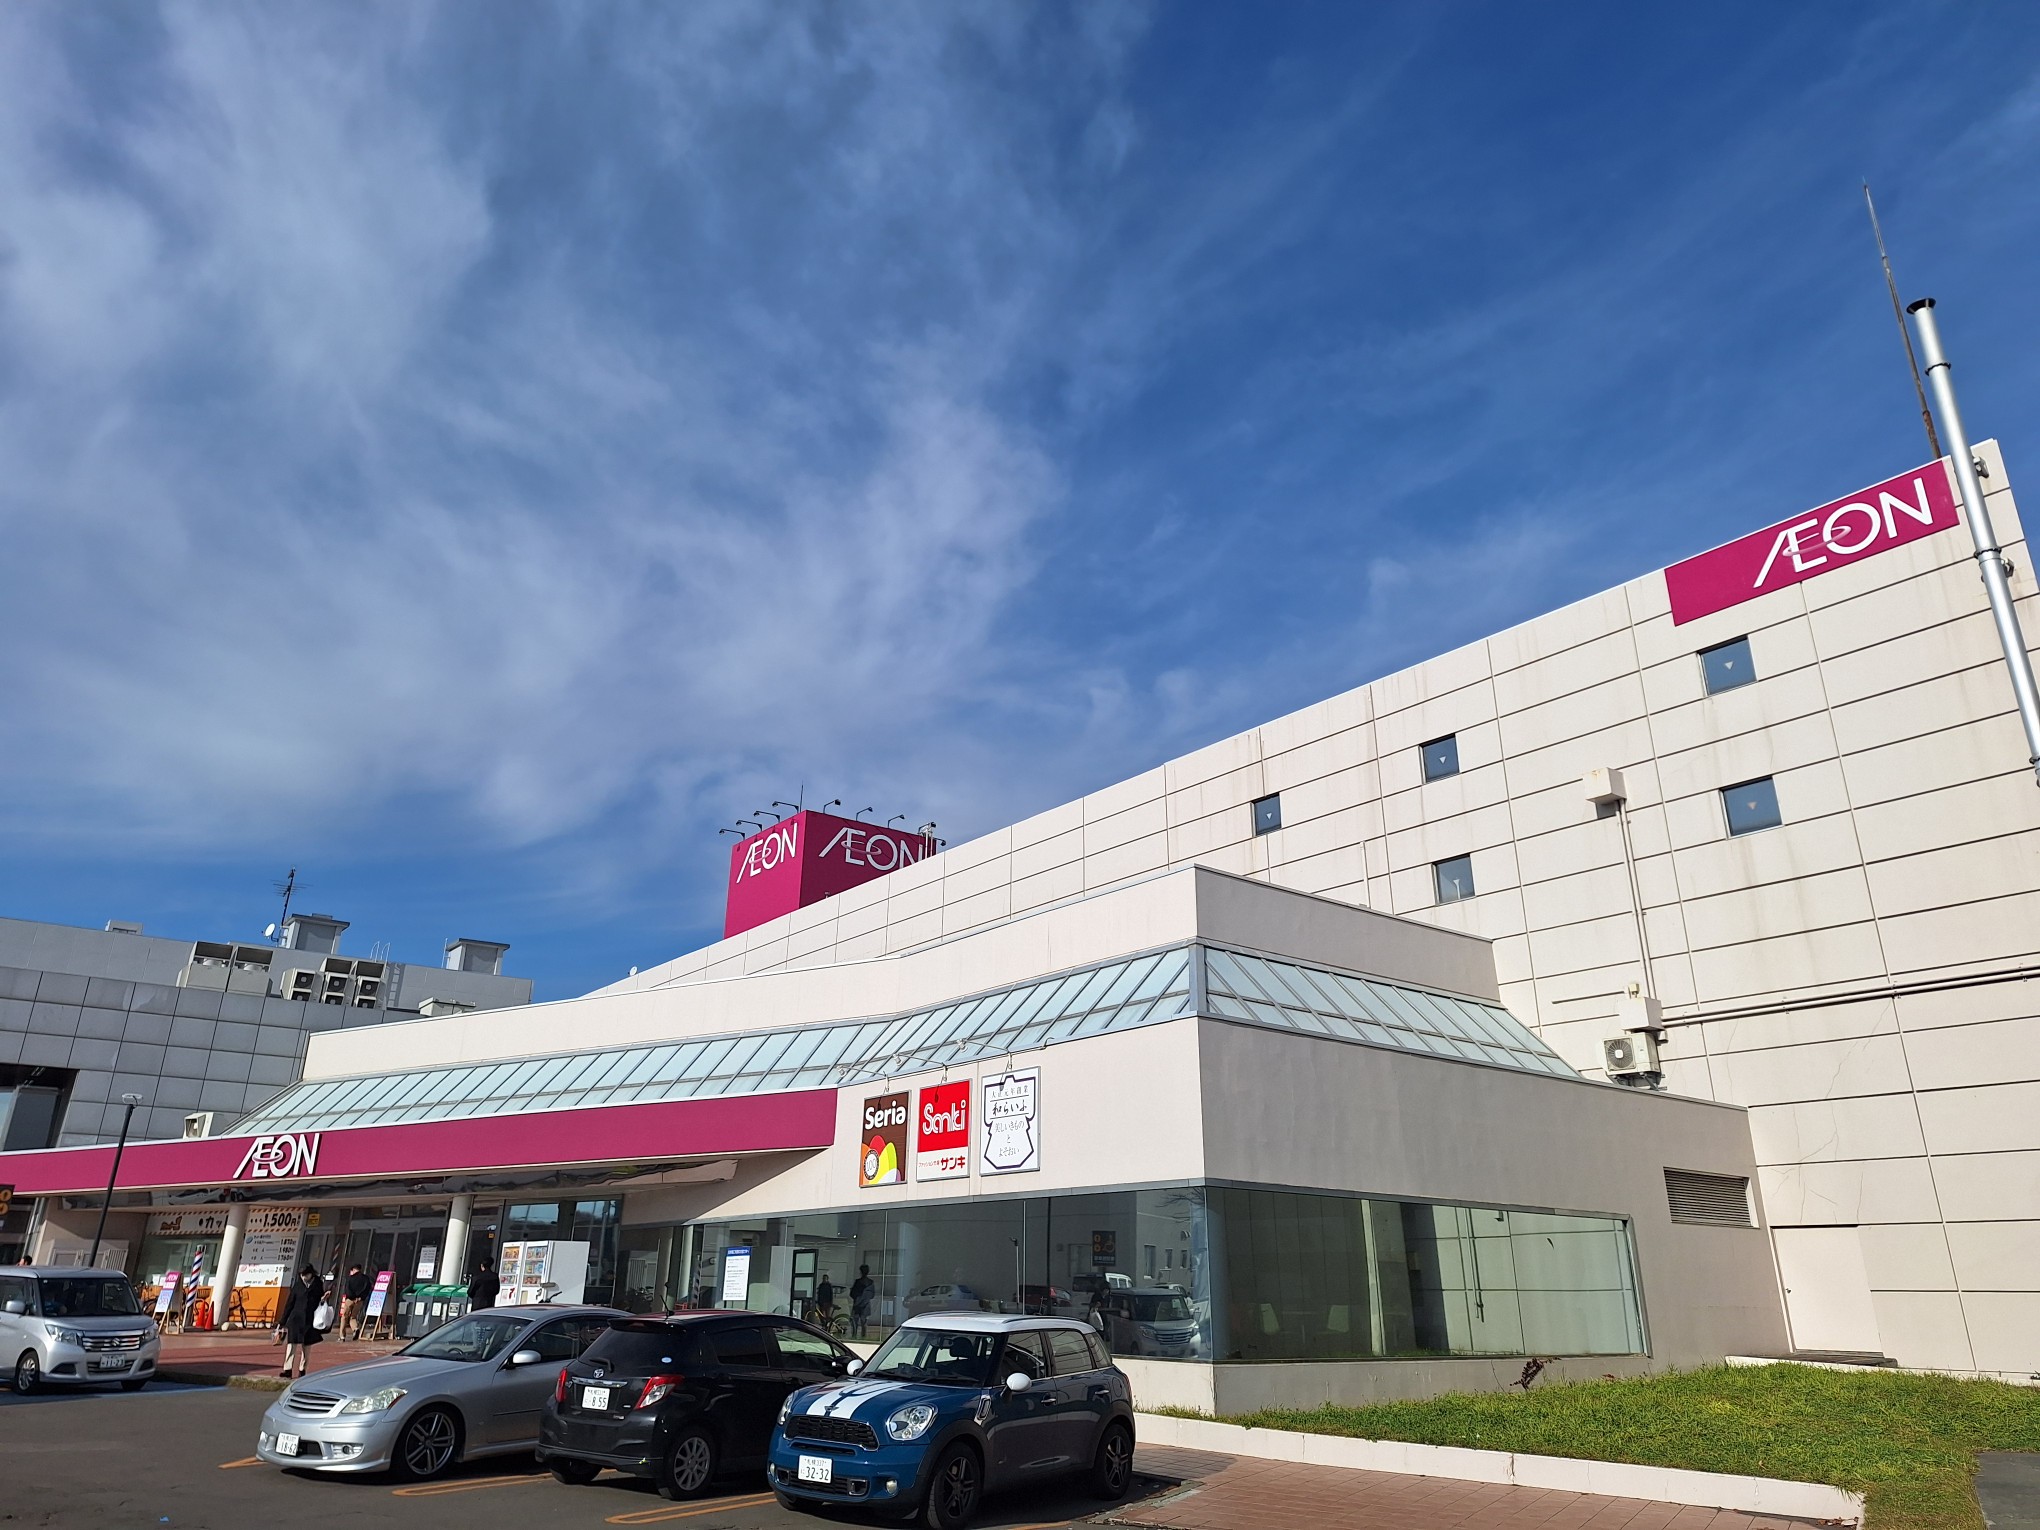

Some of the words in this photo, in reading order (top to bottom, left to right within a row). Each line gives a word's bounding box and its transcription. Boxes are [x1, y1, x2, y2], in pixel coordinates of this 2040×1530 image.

[864, 1100, 907, 1130] Seria
[922, 1099, 967, 1135] Sanki
[940, 1155, 966, 1171] サンキ
[805, 1466, 829, 1481] 32-32
